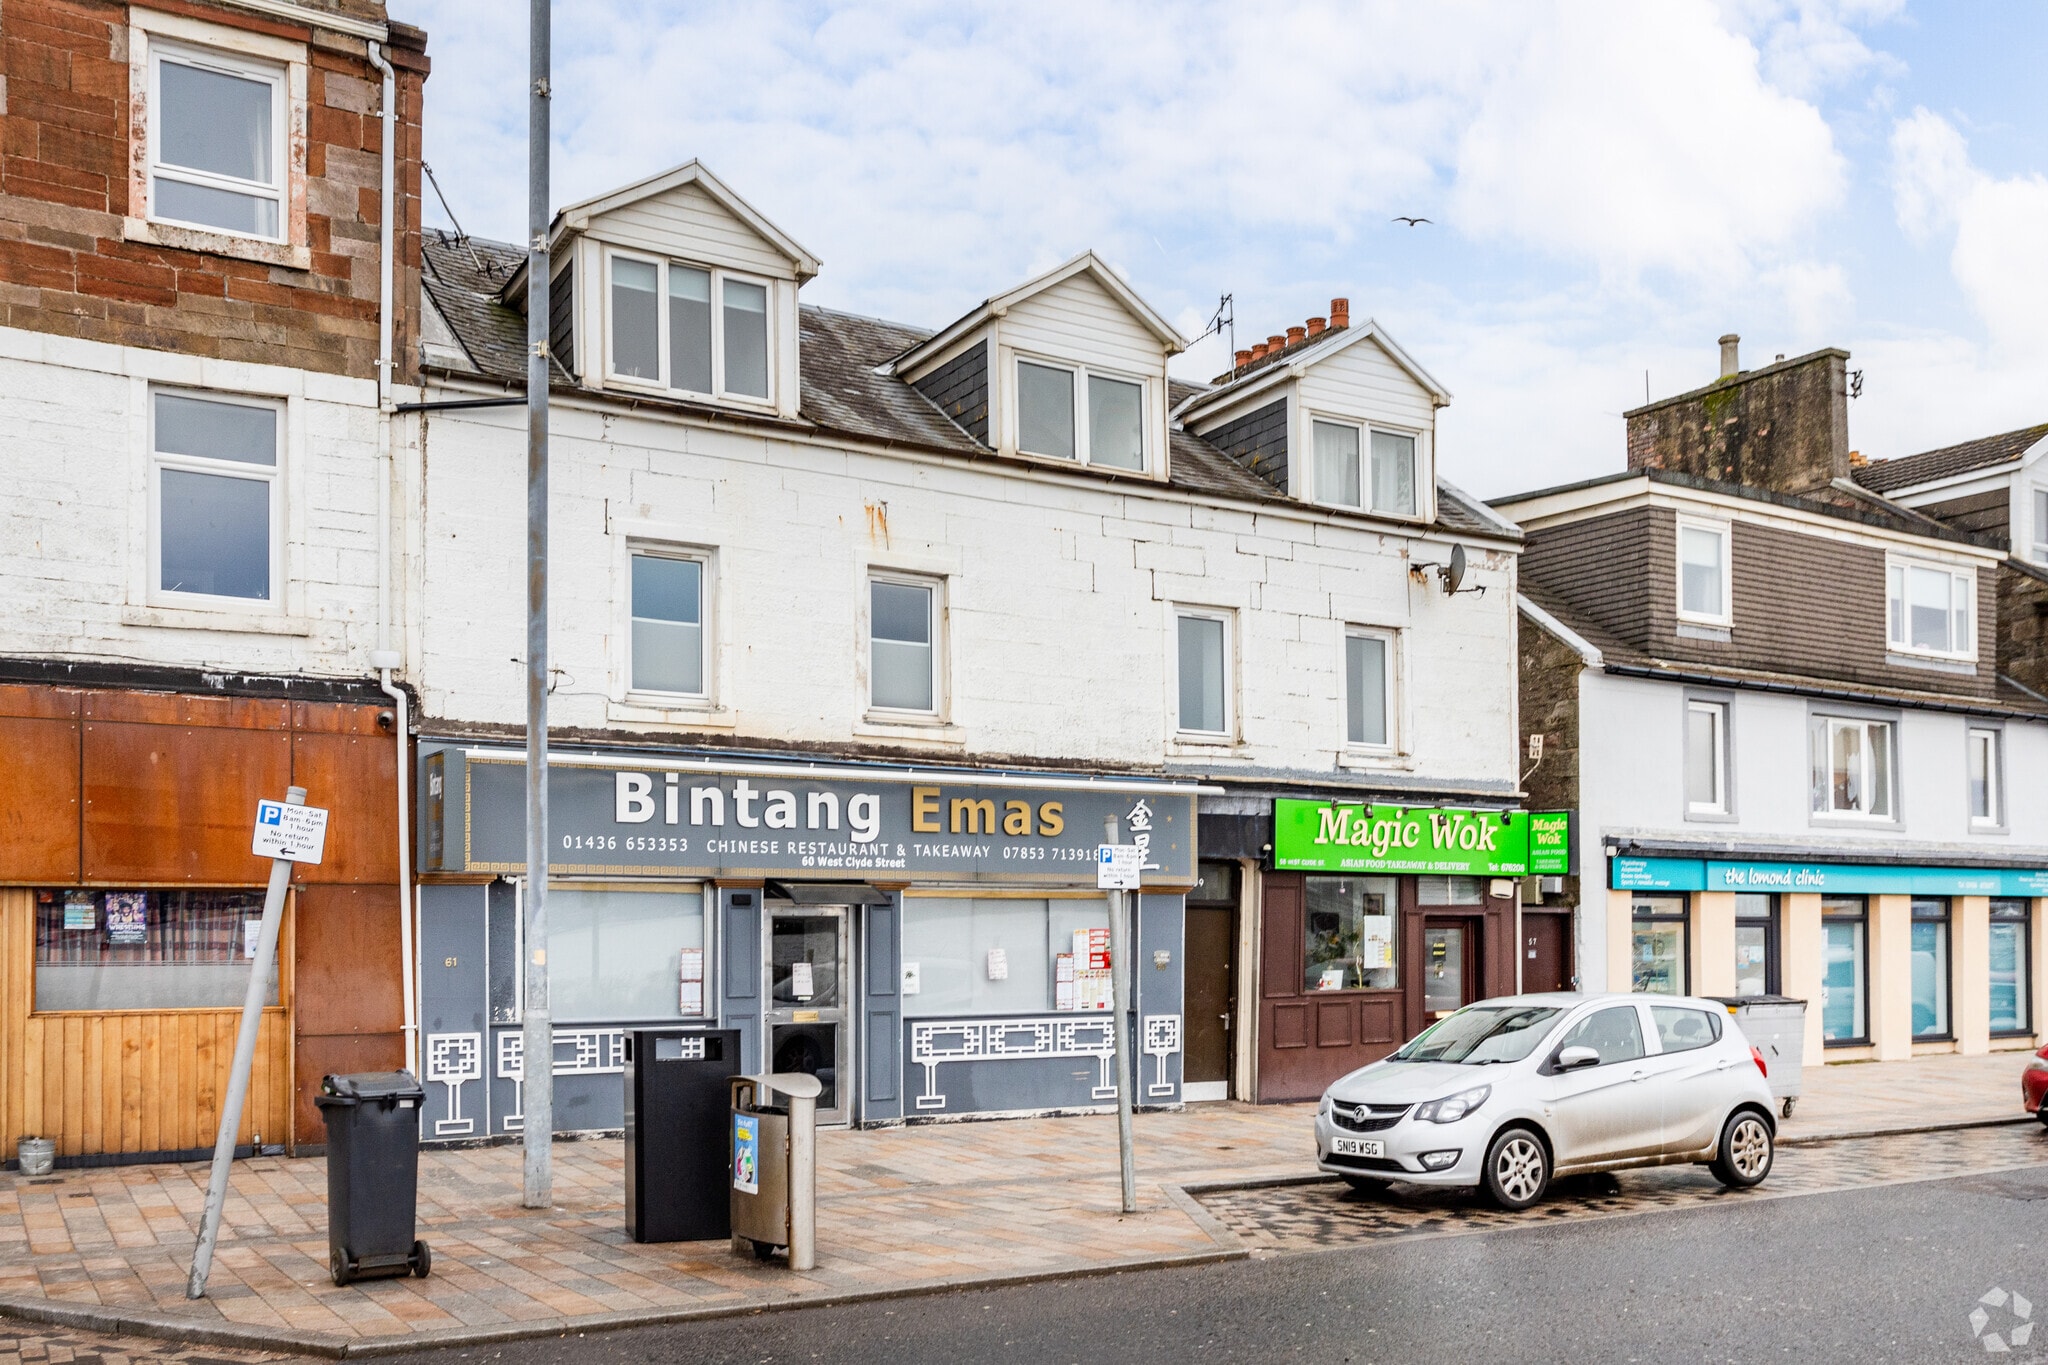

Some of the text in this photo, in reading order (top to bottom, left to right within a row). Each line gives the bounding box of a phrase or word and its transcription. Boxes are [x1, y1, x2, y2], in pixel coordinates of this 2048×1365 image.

[615, 771, 1065, 843] Bintang Emas
[296, 823, 314, 833] hour
[1314, 807, 1498, 858] Magic Wok
[1532, 818, 1567, 834] Magic
[262, 837, 287, 847] within
[296, 841, 315, 850] hour
[284, 832, 310, 842] return
[1536, 832, 1562, 845] Wok
[562, 834, 617, 850] 01436
[626, 836, 688, 852] 653353
[706, 839, 779, 855] CHINESE
[787, 841, 889, 857] RESTAURANT
[896, 843, 906, 857] &
[913, 844, 991, 859] TAKEAWAY
[1003, 846, 1045, 860] 07853
[801, 856, 906, 869] 60 West Clyde Street
[1340, 858, 1471, 871] ASIAN FOOD TAKEAWAY & DELIVERY
[1725, 867, 1825, 886] the lomond clinic
[445, 957, 457, 968] 61
[1337, 1139, 1378, 1155] SN19 WSG
